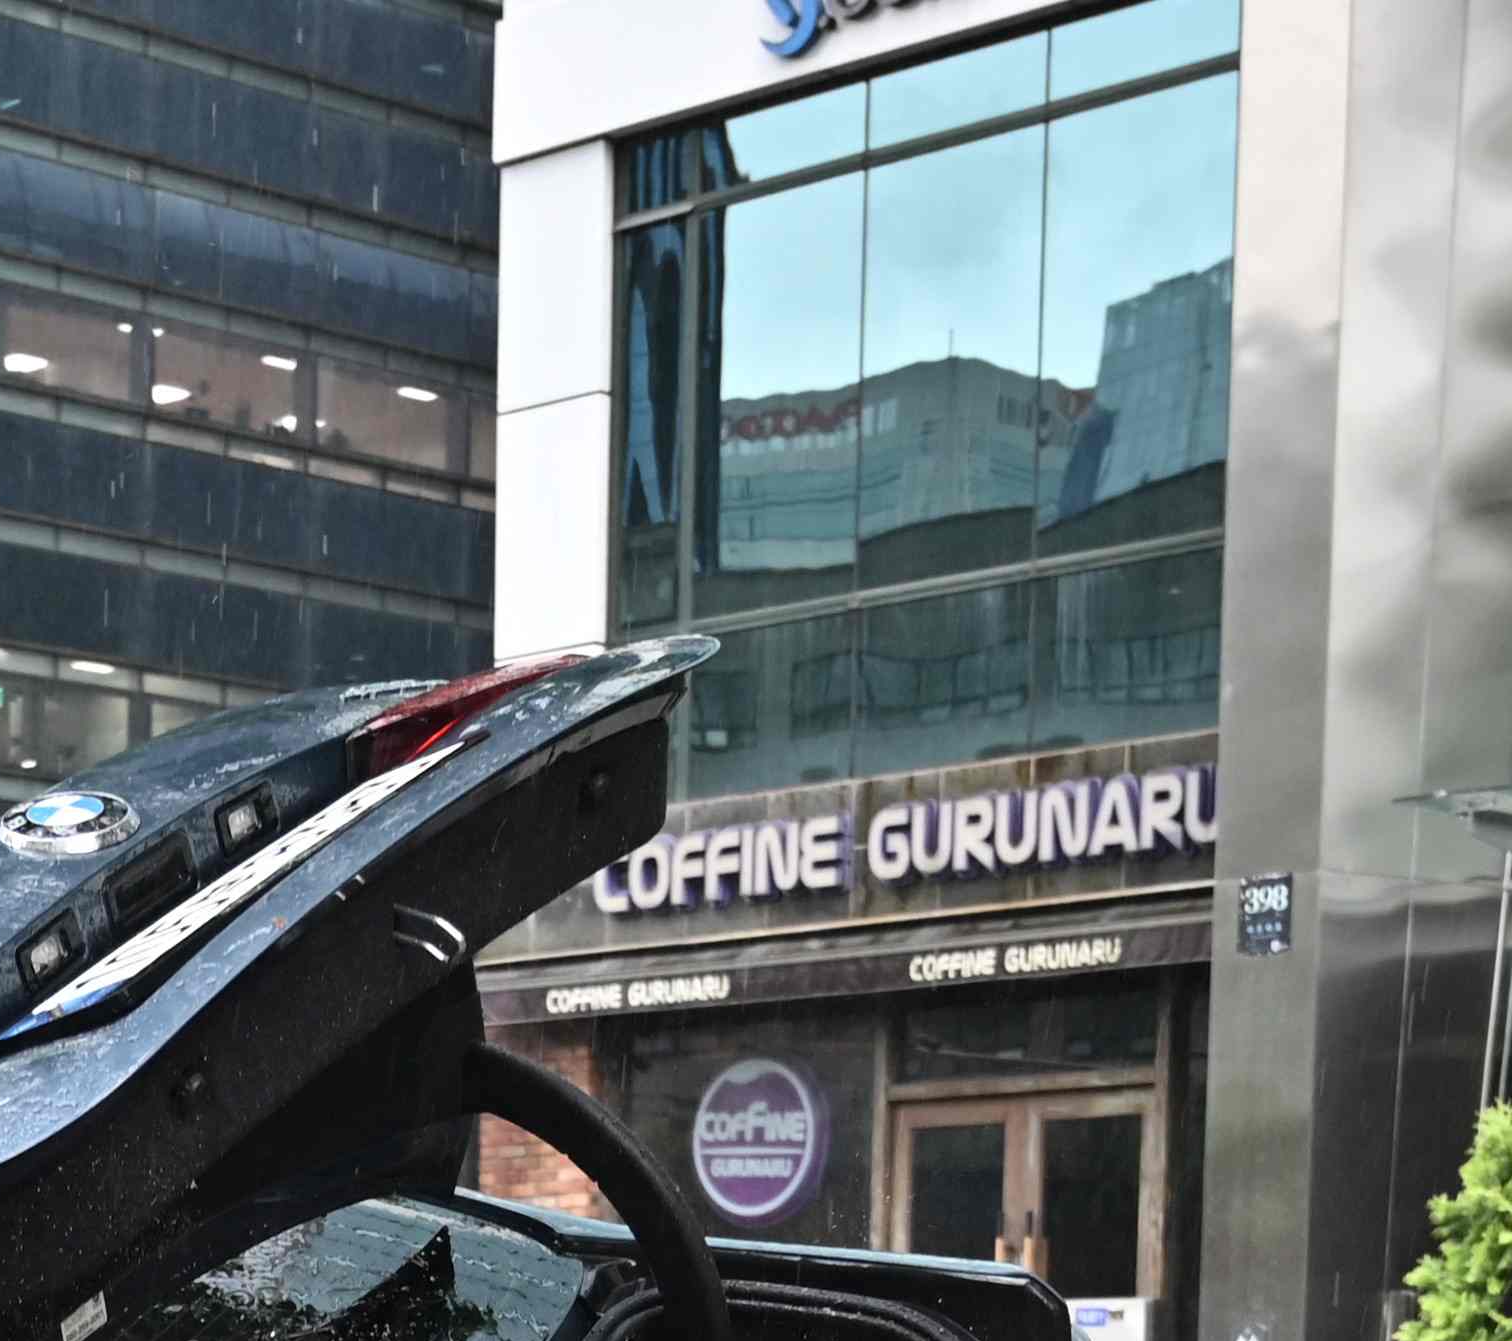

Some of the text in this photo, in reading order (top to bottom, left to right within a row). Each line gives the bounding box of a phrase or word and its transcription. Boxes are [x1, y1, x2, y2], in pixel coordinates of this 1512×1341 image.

[1244, 885, 1288, 914] 398
[910, 937, 1121, 982] COFFINE GURUNARU
[545, 974, 730, 1013] COFFINE GURUNARU
